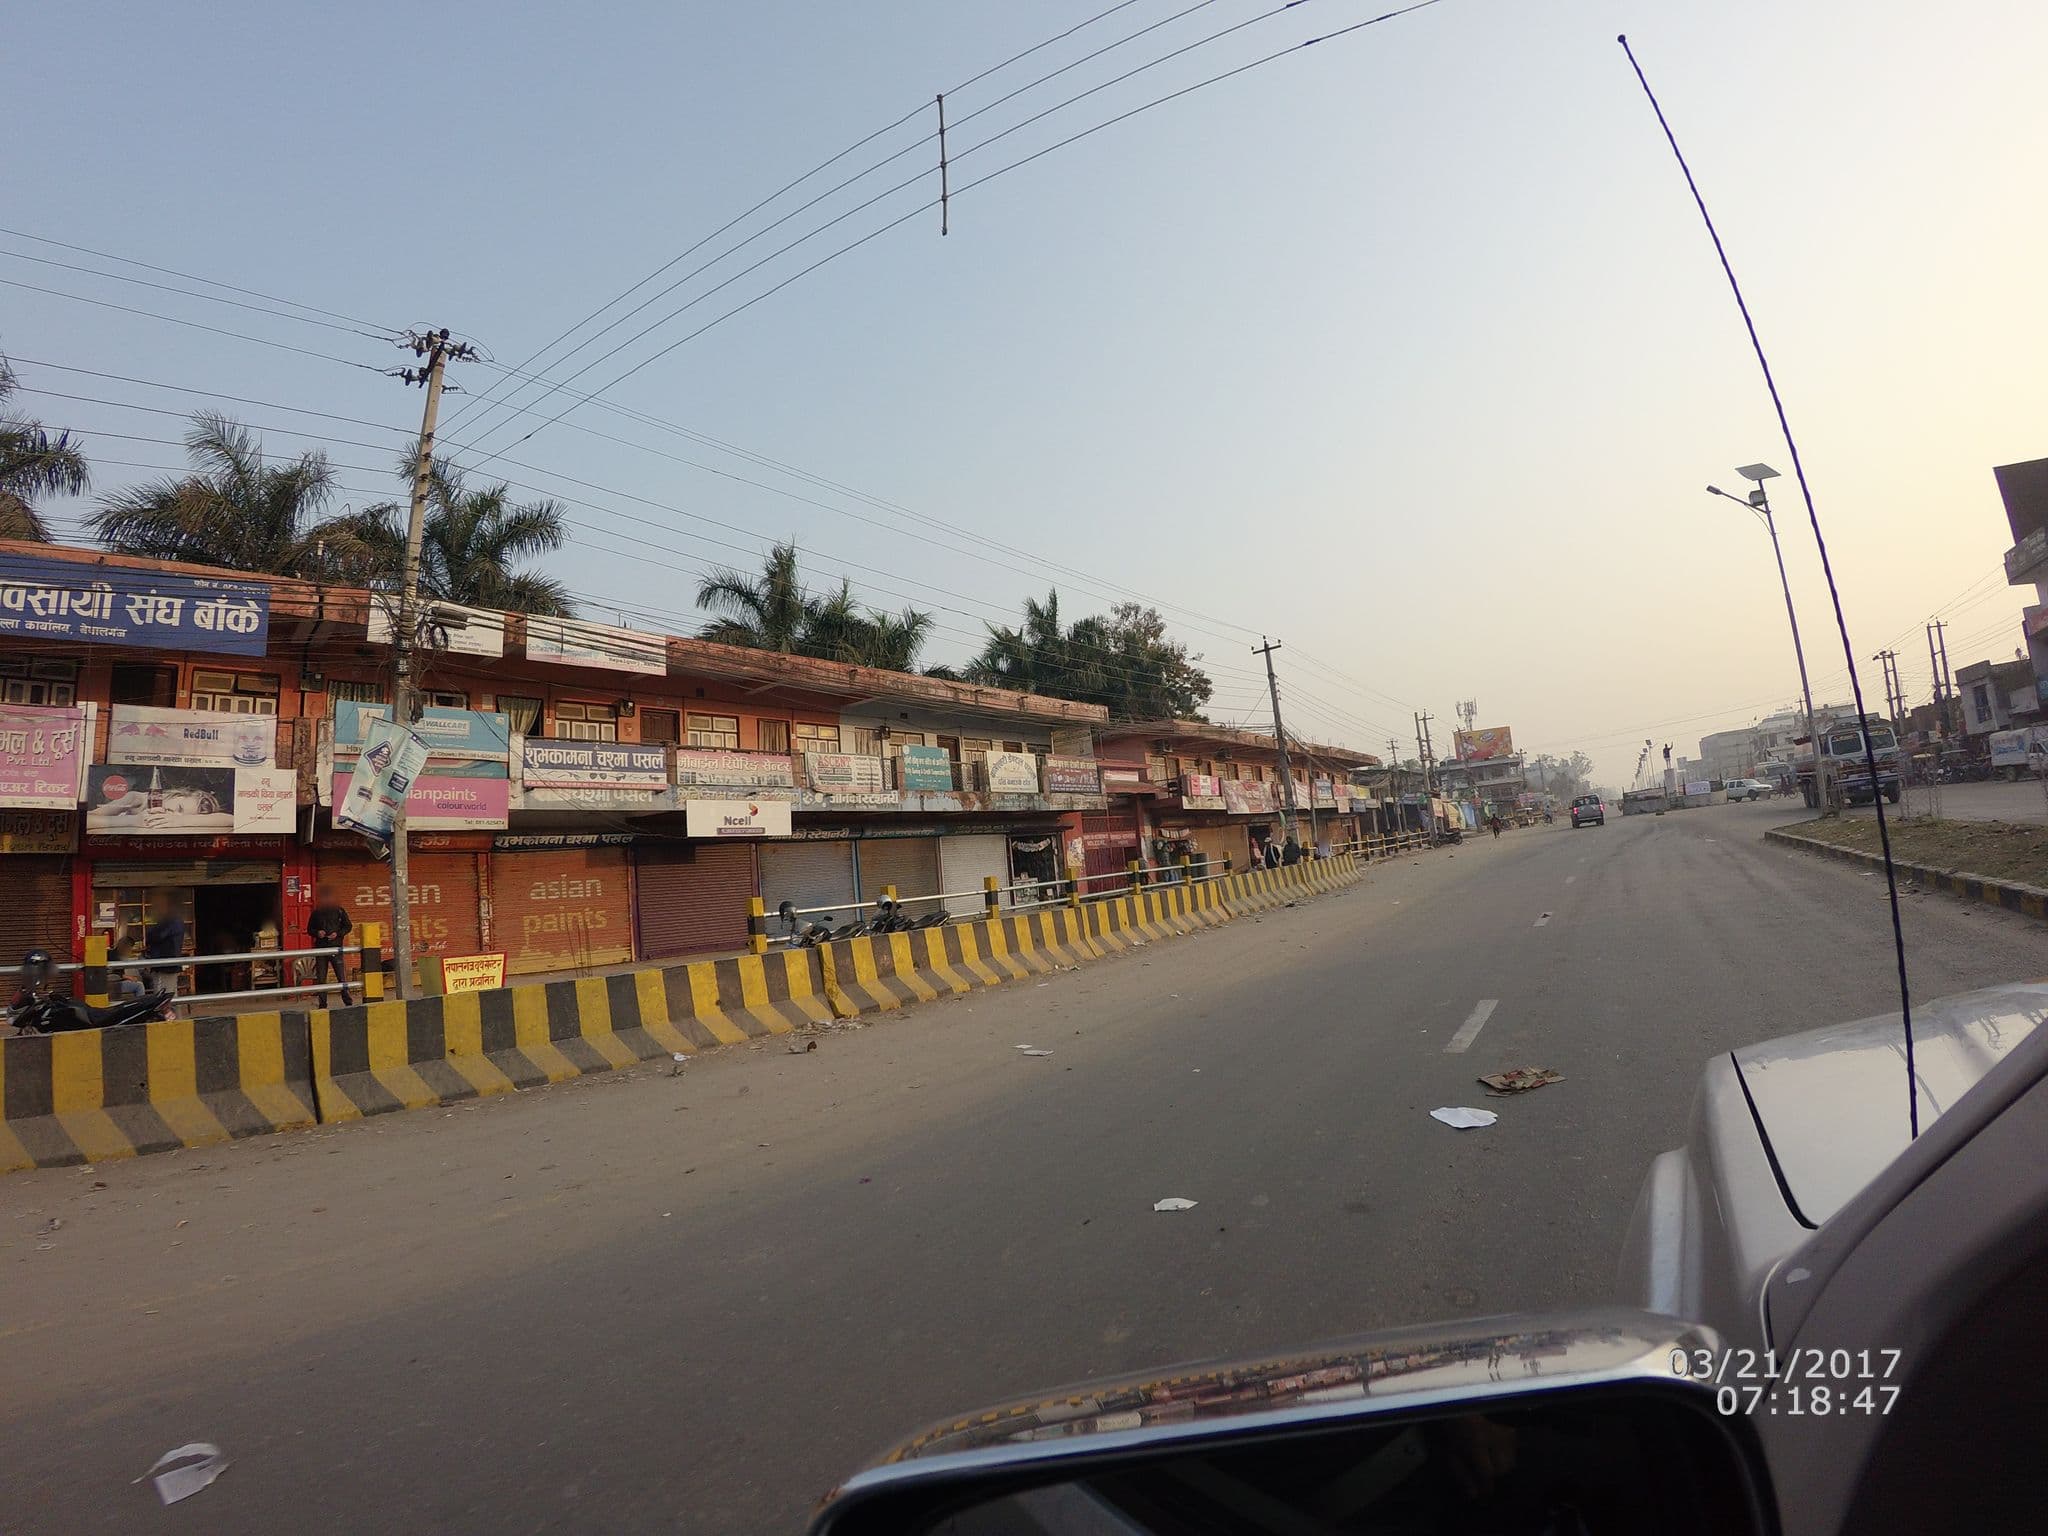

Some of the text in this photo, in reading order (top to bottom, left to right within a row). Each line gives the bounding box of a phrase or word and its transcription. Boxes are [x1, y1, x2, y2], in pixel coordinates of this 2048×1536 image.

[126, 588, 185, 626] संघ
[194, 594, 262, 633] बाँके
[33, 727, 45, 755] &
[524, 746, 665, 769] शुभकामना चश्मा पसल
[406, 787, 477, 804] ianpaints
[724, 815, 752, 825] Ncell
[355, 884, 441, 906] asan
[530, 873, 602, 899] asian
[523, 905, 608, 947] paints
